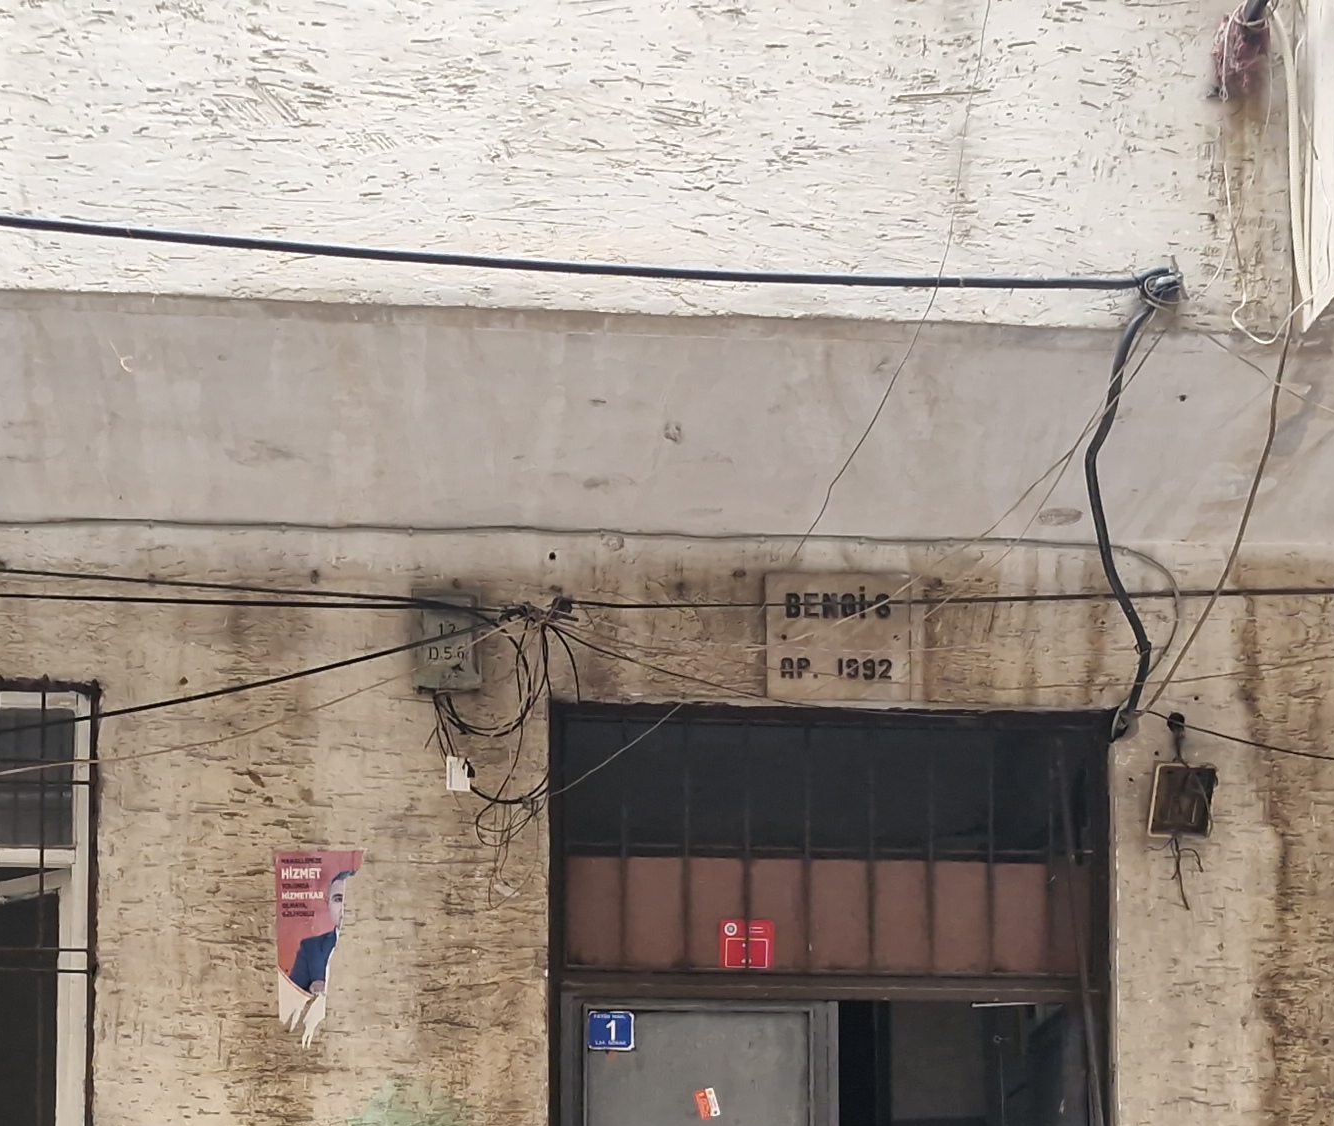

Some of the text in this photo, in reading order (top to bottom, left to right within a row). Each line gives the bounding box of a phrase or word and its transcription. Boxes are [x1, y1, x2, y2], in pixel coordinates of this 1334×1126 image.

[780, 657, 893, 680] AP. 1992
[281, 866, 322, 880] HİZMET
[605, 1019, 616, 1041] 1
